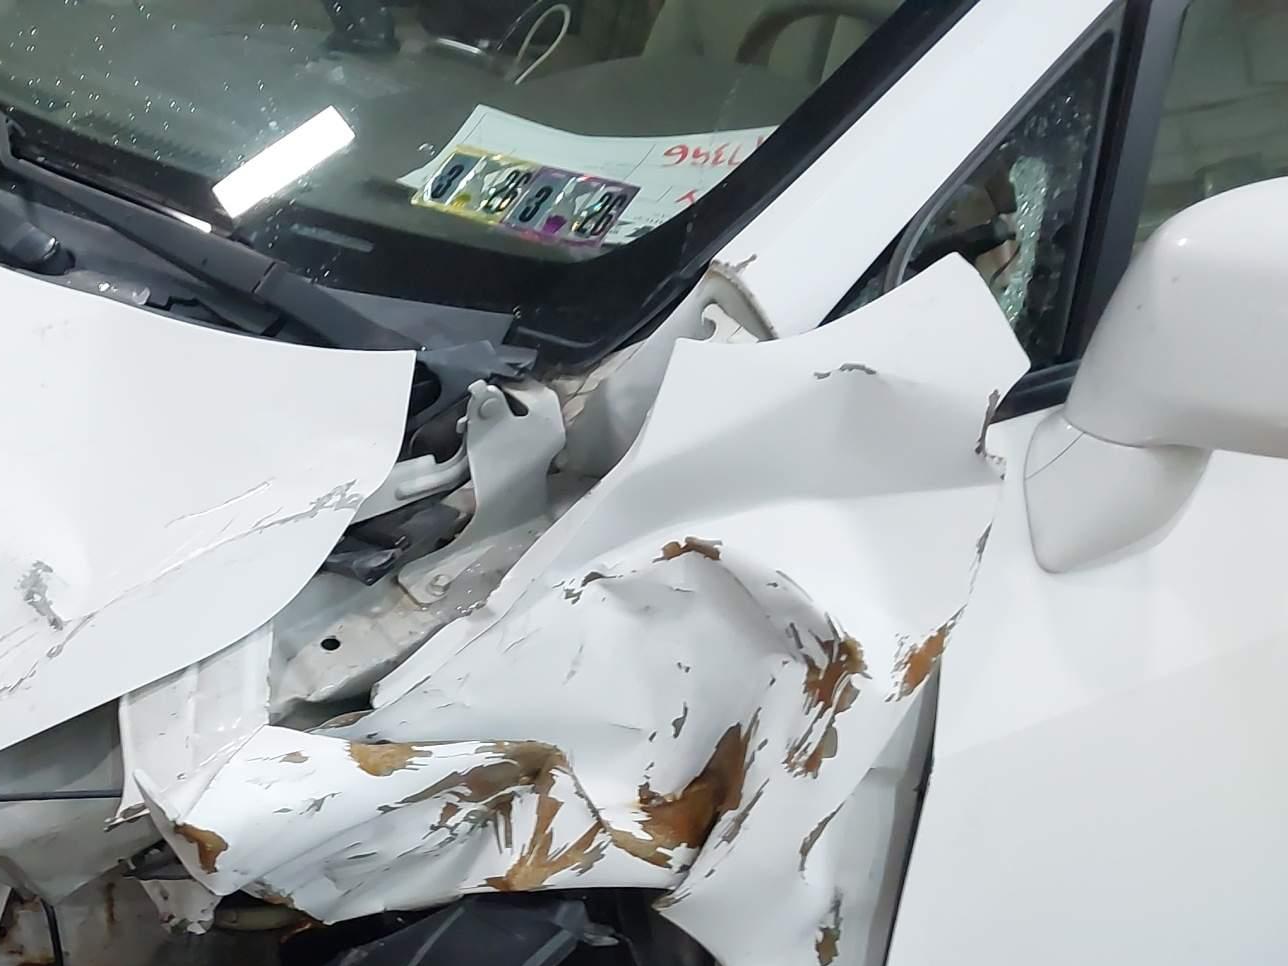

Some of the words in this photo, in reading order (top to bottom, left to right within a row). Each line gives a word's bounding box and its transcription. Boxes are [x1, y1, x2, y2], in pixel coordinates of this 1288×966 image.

[431, 164, 465, 200] 3
[485, 170, 531, 214] 26
[519, 186, 554, 222] 3
[576, 191, 629, 237] 26
